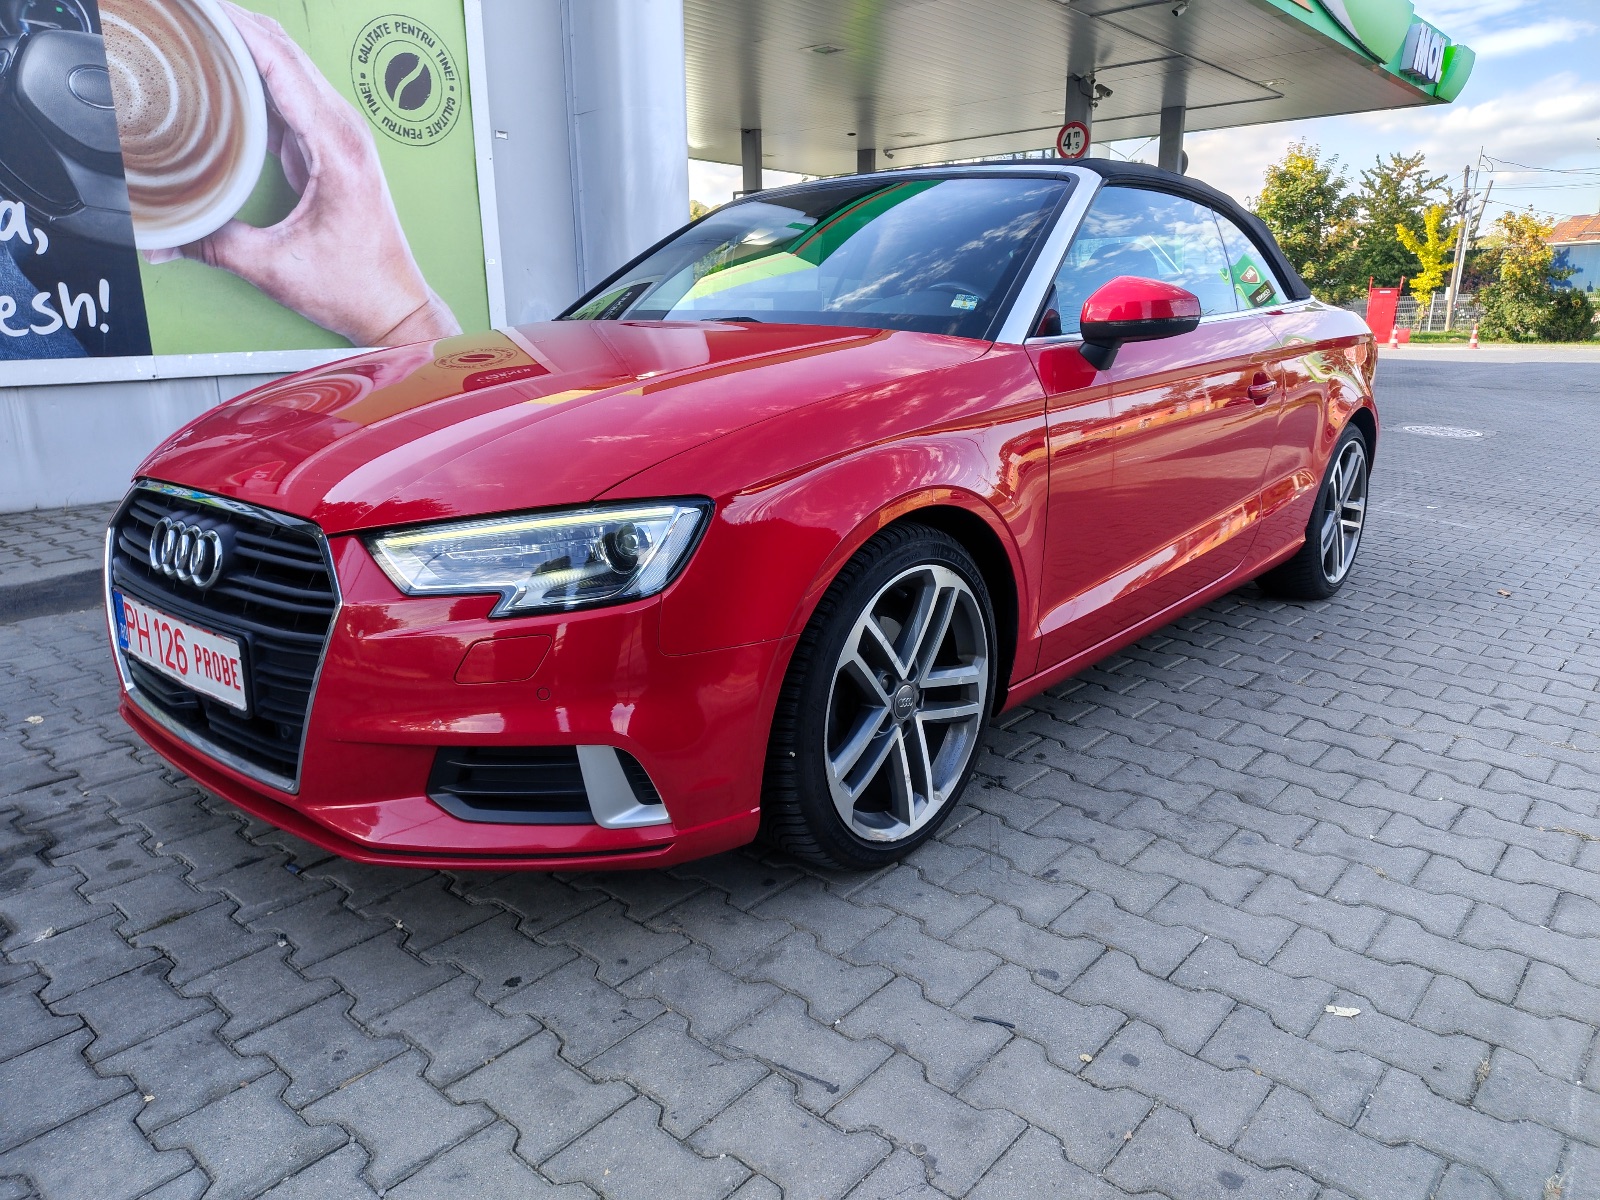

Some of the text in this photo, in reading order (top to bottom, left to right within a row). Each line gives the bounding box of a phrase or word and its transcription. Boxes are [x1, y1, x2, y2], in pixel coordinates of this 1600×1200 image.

[358, 21, 455, 81] CALITATE PENTRU TINE!
[359, 82, 381, 116] TINE!
[425, 97, 456, 138] CALITATE
[123, 601, 241, 691] PH 126 PROBE
